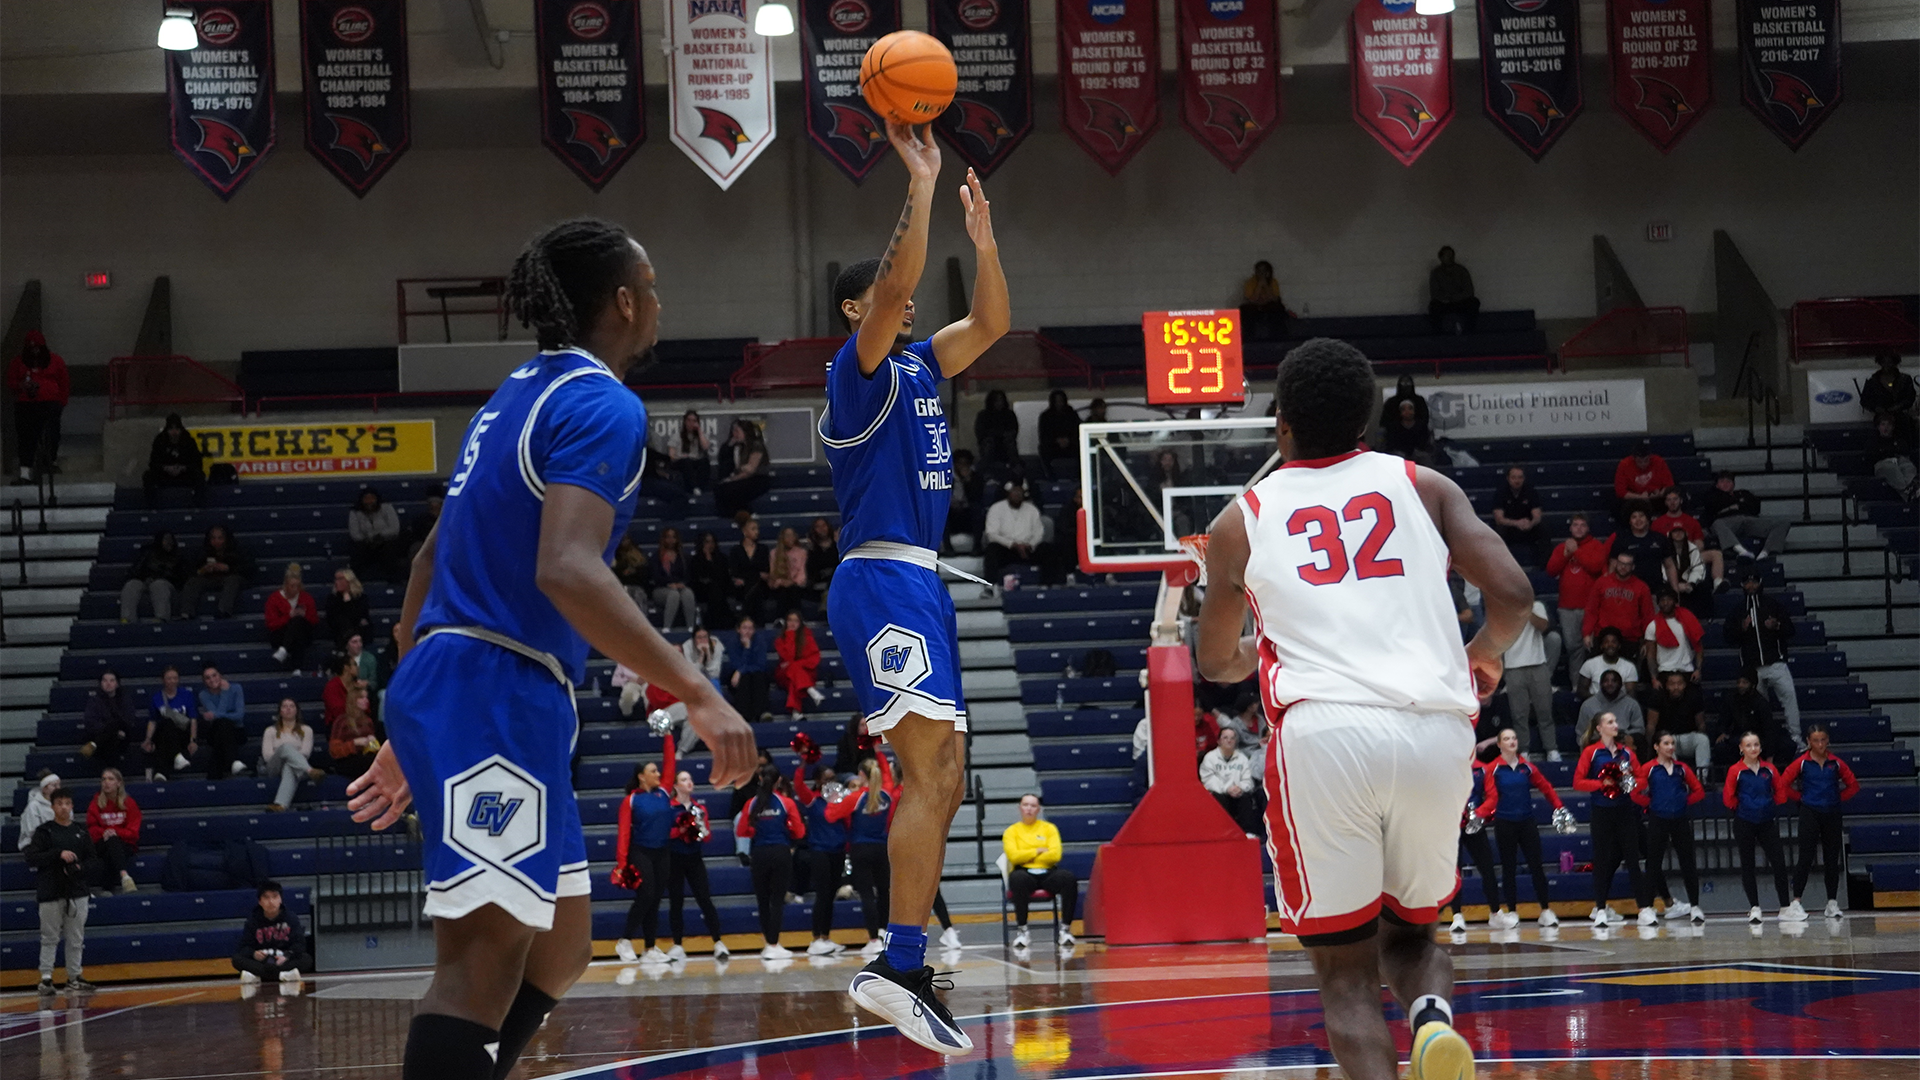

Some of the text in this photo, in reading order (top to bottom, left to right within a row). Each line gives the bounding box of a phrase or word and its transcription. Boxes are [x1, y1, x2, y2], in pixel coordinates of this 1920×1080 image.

[689, 0, 746, 19] NAIA
[1091, 4, 1126, 17] NCAA
[1210, 0, 1243, 12] NCAA
[1761, 5, 1816, 19] WOMEN'S
[1501, 15, 1556, 30] WOMEN'S
[1630, 9, 1687, 23] WOMEN'S
[1372, 18, 1428, 31] WOMEN'S
[1623, 24, 1696, 39] BASKETBALL
[1753, 20, 1825, 35] BASKETBALL
[691, 28, 747, 40] WOMEN'S
[1080, 31, 1136, 44] WOMEN'S
[1199, 26, 1254, 40] WOMEN'S
[1365, 33, 1437, 47] BASKETBALL
[1493, 30, 1566, 46] BASKETBALL
[951, 34, 1007, 47] WOMEN'S
[1623, 39, 1698, 54] ROUND OF 32
[1754, 35, 1825, 48] NORTH DIVISION
[325, 48, 383, 62] WOMEN'S
[560, 43, 618, 57] WOMEN'S
[683, 43, 755, 55] BASKETBALL
[953, 49, 1016, 62] ASKETBALL
[1072, 46, 1144, 60] BASKETBALL
[1191, 42, 1264, 56] BASKETBALL
[1365, 47, 1439, 62] ROUND OF 32
[1495, 46, 1565, 59] NORTH DIVISION
[1761, 49, 1820, 63] 2016-2017
[190, 50, 249, 64] WOMEN'S
[692, 58, 747, 70] NATIONAL
[816, 53, 862, 67] BASKET
[1191, 56, 1265, 71] ROUND OF 32
[1631, 55, 1690, 70] 2016-2017
[182, 65, 259, 79] BASKETBALL
[317, 63, 392, 77] BASKETBALL
[553, 58, 628, 73] BASKETBALL
[1072, 61, 1146, 75] ROUND OF 16
[1372, 63, 1433, 77] 2015-2016
[1501, 58, 1562, 74] 2015-2016
[556, 73, 627, 88] CHAMPIONS
[688, 73, 753, 86] RUNNER-UP
[818, 69, 860, 82] CHAMP
[1199, 72, 1259, 86] 1996-1997
[184, 81, 257, 95] CHAMPIONS
[320, 78, 391, 93] CHAMPIONS
[957, 78, 1010, 92] 986-1987
[1080, 76, 1140, 90] 1992-1993
[562, 89, 622, 103] 1984-1985
[693, 88, 750, 101] 1984-1985
[824, 84, 863, 97] 1985-1
[191, 96, 253, 110] 1975-1976
[326, 94, 386, 108] 1983-1984
[1168, 309, 1215, 317] DAKTRONICS
[1163, 317, 1233, 346] 15:42
[1168, 348, 1224, 394] 23
[1468, 389, 1610, 410] United Financial
[1822, 392, 1846, 403] Ford
[1468, 410, 1611, 426] CREDIT UNION
[197, 426, 398, 457] DICKEY'S
[924, 422, 951, 464] 30
[238, 457, 373, 473] ARBECUE PIT
[1286, 491, 1405, 586] 32
[880, 645, 913, 674] GV
[466, 791, 525, 836] GV
